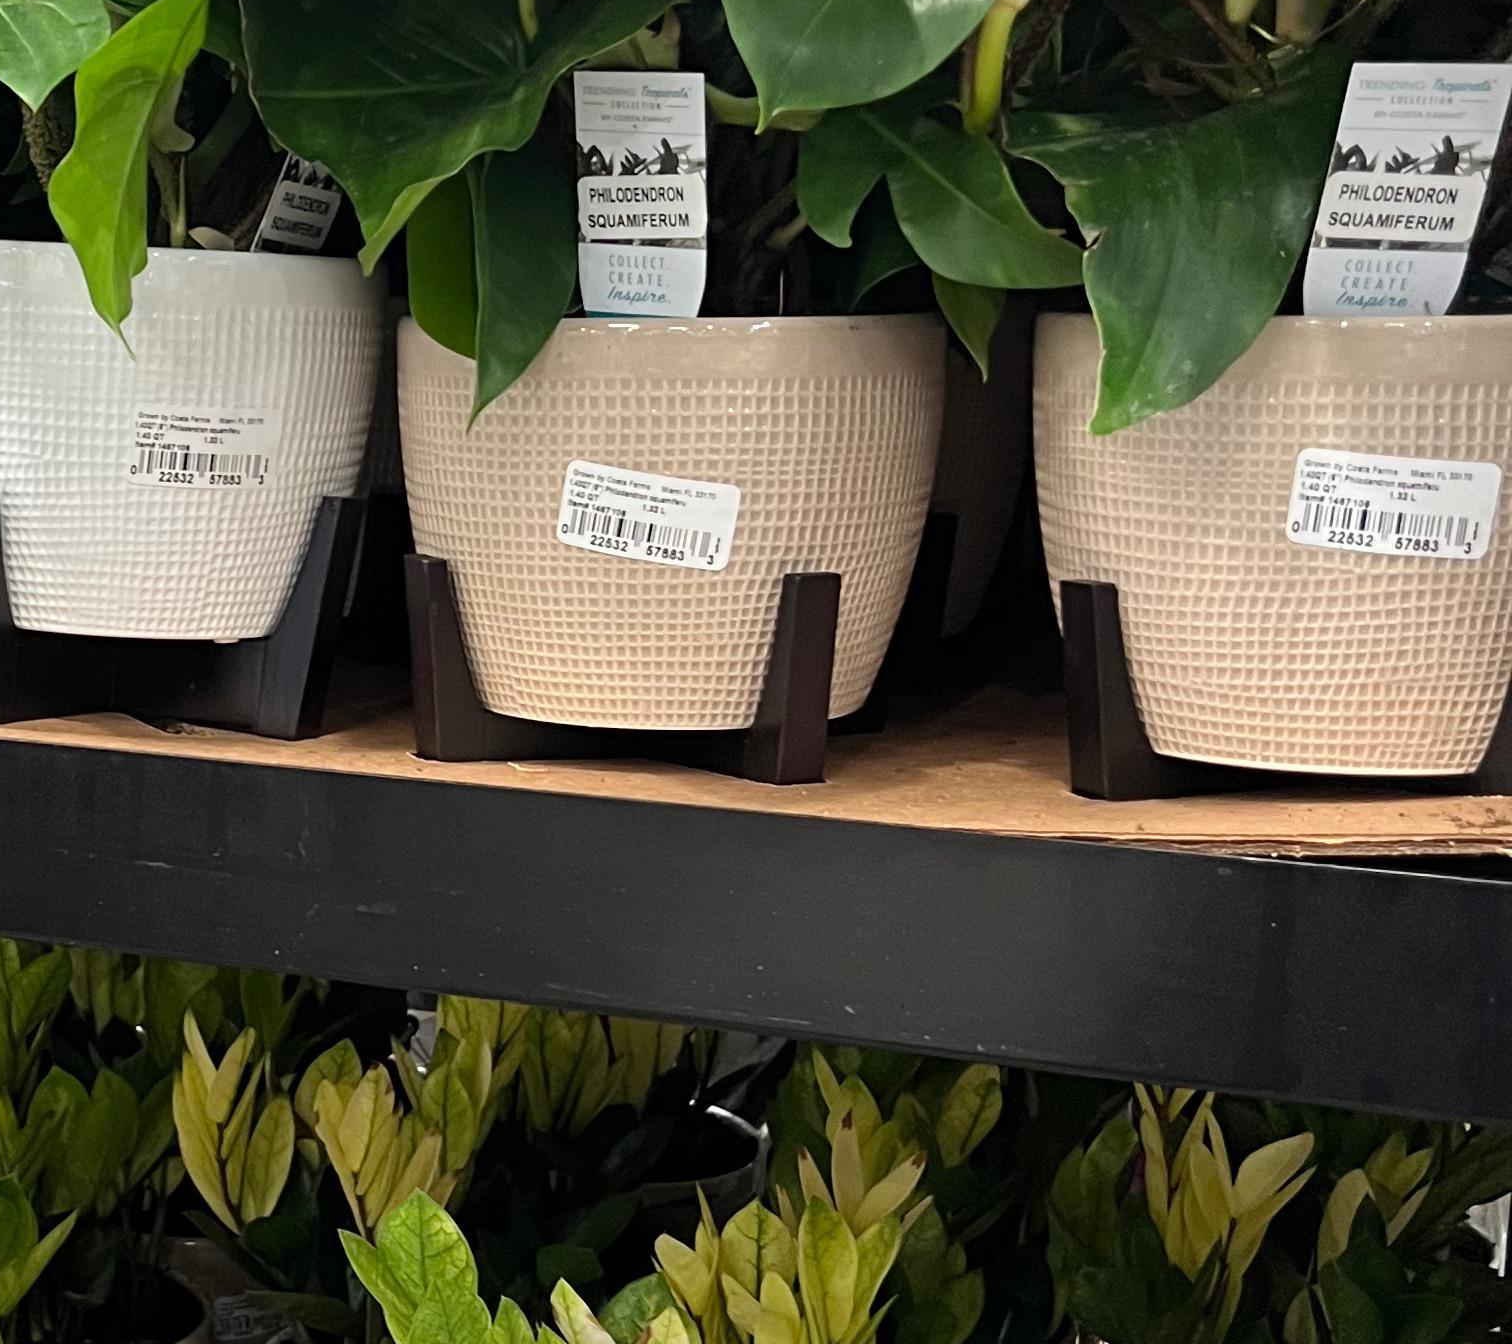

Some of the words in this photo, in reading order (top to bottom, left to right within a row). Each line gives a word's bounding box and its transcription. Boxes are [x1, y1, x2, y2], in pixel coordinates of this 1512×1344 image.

[589, 187, 684, 203] PHILODENDRON
[1339, 183, 1459, 204] PHILODENDRON
[588, 213, 690, 228] SQUAMIFERUM
[1328, 211, 1455, 231] SQUAMIFERUM
[130, 464, 137, 475] 0
[158, 471, 194, 485] 22532
[209, 474, 242, 485] 57883
[561, 523, 569, 534] 0
[590, 534, 629, 552] 22532
[646, 545, 685, 561] 57883
[706, 555, 714, 565] 3
[1292, 521, 1300, 533] 0
[1327, 531, 1374, 547] 22532
[1395, 537, 1439, 552] 57883
[1464, 543, 1472, 554] 3
